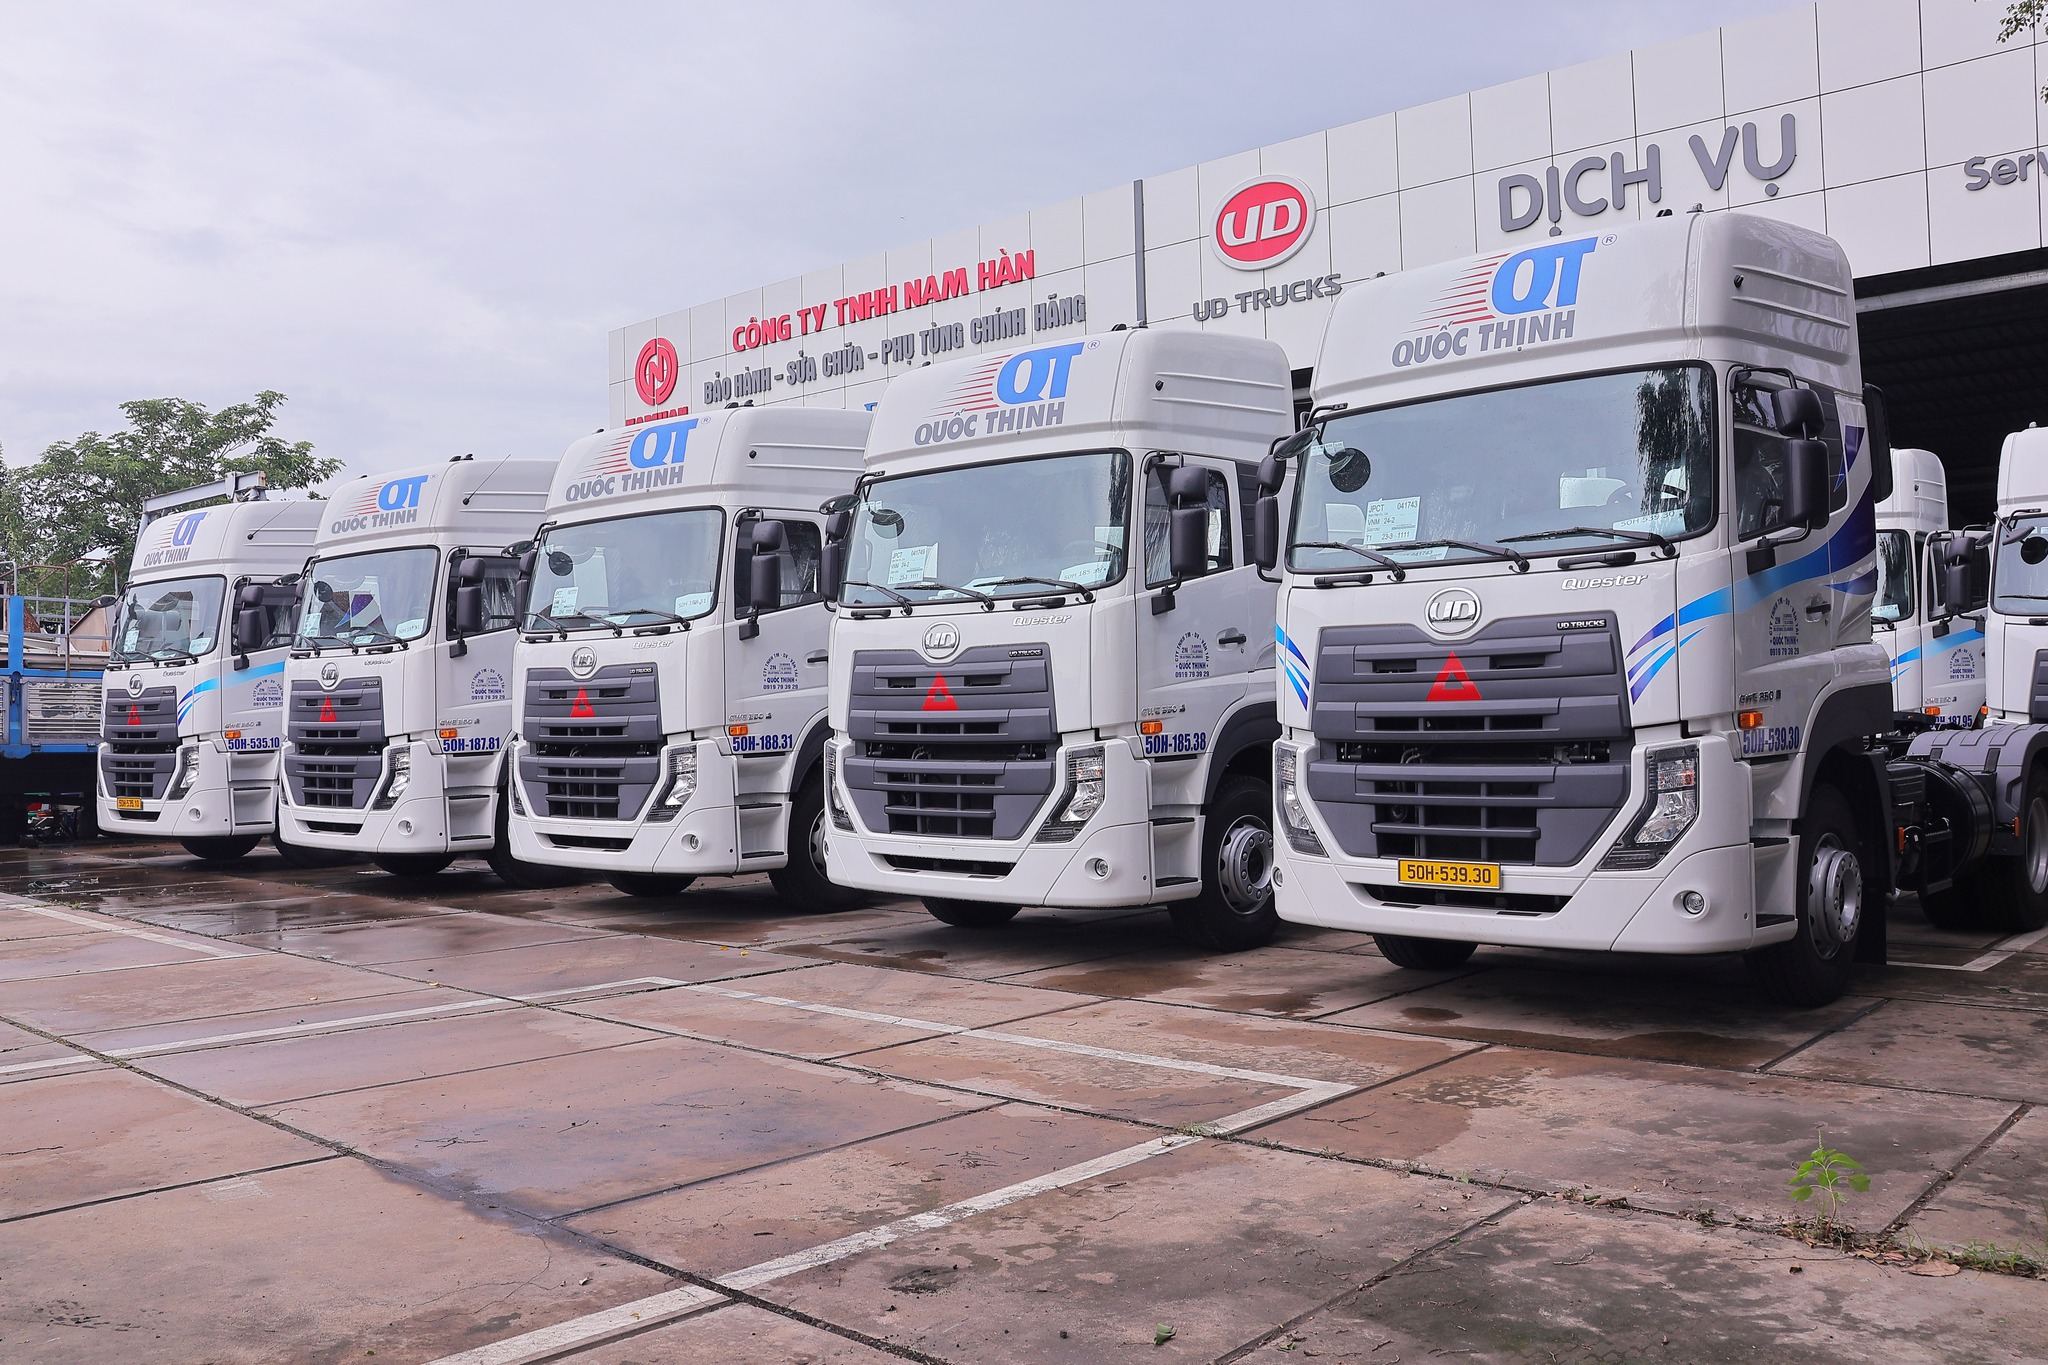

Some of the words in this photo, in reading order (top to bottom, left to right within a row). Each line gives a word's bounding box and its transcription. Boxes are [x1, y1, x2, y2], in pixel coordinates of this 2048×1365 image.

[1499, 144, 1662, 237] DỊCH
[1689, 113, 1797, 197] VỤ
[1221, 198, 1300, 247] UD
[1491, 237, 1598, 315] QT
[732, 317, 792, 352] CÔNG
[797, 303, 828, 336] TY
[834, 286, 898, 326] TNHH
[903, 267, 969, 310] NAM
[977, 248, 1035, 291] HÀN
[1193, 298, 1228, 321] UD
[1235, 273, 1342, 313] TRUCKS
[704, 371, 731, 404] BẢO
[734, 358, 771, 396] HÀNH
[787, 350, 816, 386] SỬA
[822, 342, 864, 377] CHỮA
[881, 332, 914, 366] PHỤ
[919, 321, 965, 356] TÙNG
[970, 306, 1026, 350] CHÍNH
[1034, 294, 1087, 332] HÃNG
[1391, 320, 1469, 367] QUỐC
[1479, 310, 1575, 352] THỊNH
[997, 342, 1085, 404] QT
[914, 409, 977, 445] QUỐC
[986, 402, 1065, 435] THỊNH
[630, 418, 699, 468] QT
[378, 475, 429, 511] QT
[566, 472, 615, 501] QUỐC
[622, 466, 684, 493] THỊNH
[372, 509, 417, 528] THỊNH
[1369, 504, 1385, 513] JPCT
[1561, 574, 1648, 590] Quester
[1012, 615, 1071, 627] Quester
[1429, 599, 1477, 622] UD
[1571, 620, 1605, 628] TRUCKS
[925, 632, 957, 649] UD
[228, 737, 280, 750] 50H-535.10
[443, 737, 500, 751] 50H-187.81
[733, 734, 793, 751] 50H-188.31
[1145, 732, 1206, 754] 50H-185.38
[1743, 726, 1800, 754] 50H-539.30
[1407, 864, 1491, 883] 50H-539.30
